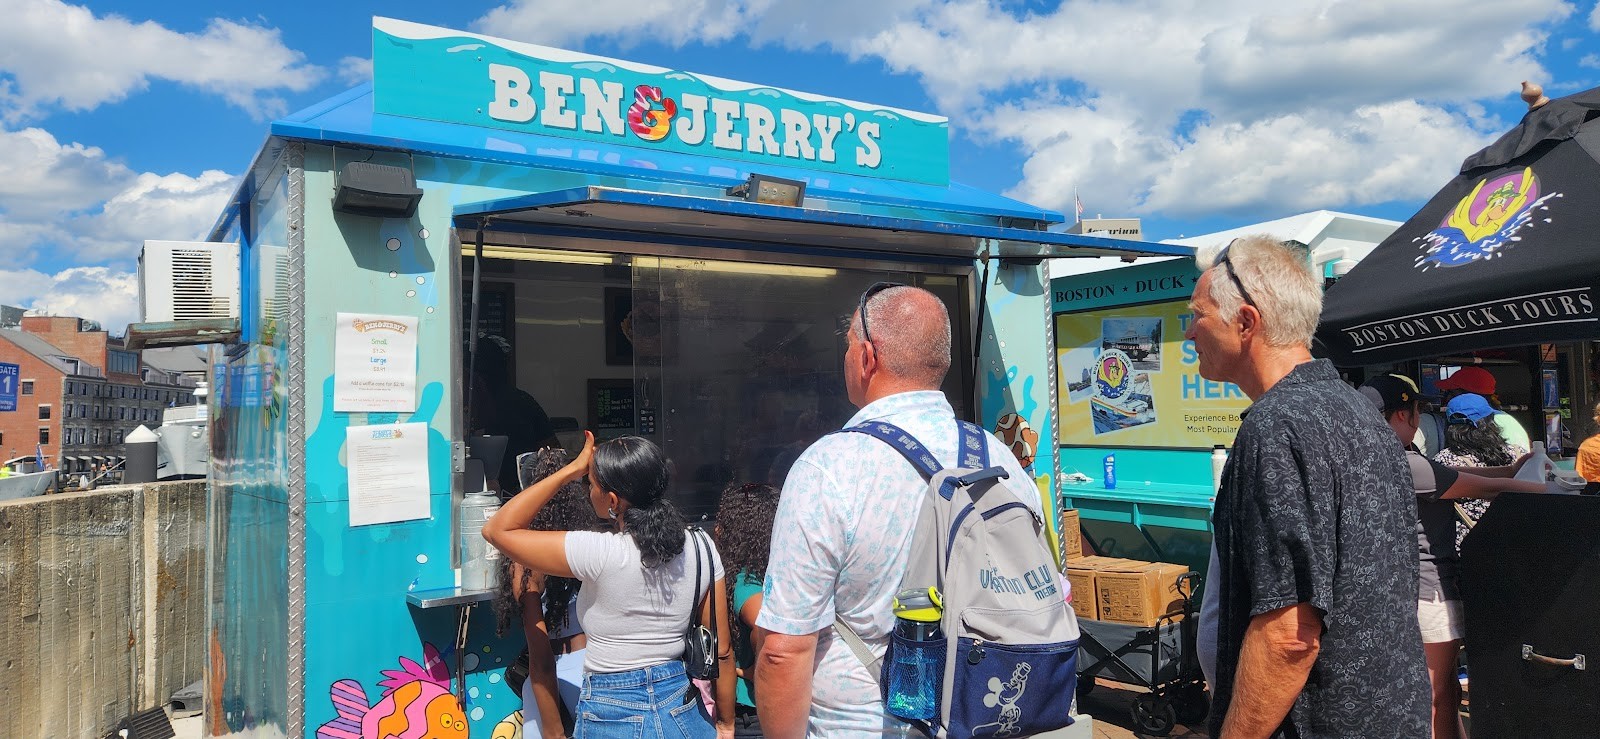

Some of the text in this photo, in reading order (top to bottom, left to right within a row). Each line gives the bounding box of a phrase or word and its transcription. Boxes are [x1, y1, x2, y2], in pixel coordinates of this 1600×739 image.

[1055, 274, 1185, 303] BOSTON DUCK
[1348, 293, 1594, 347] BOSTON DUCK TOURS
[370, 357, 387, 365] Large
[3, 376, 11, 393] 1
[1184, 414, 1227, 424] Experience
[1207, 425, 1237, 434] Popular
